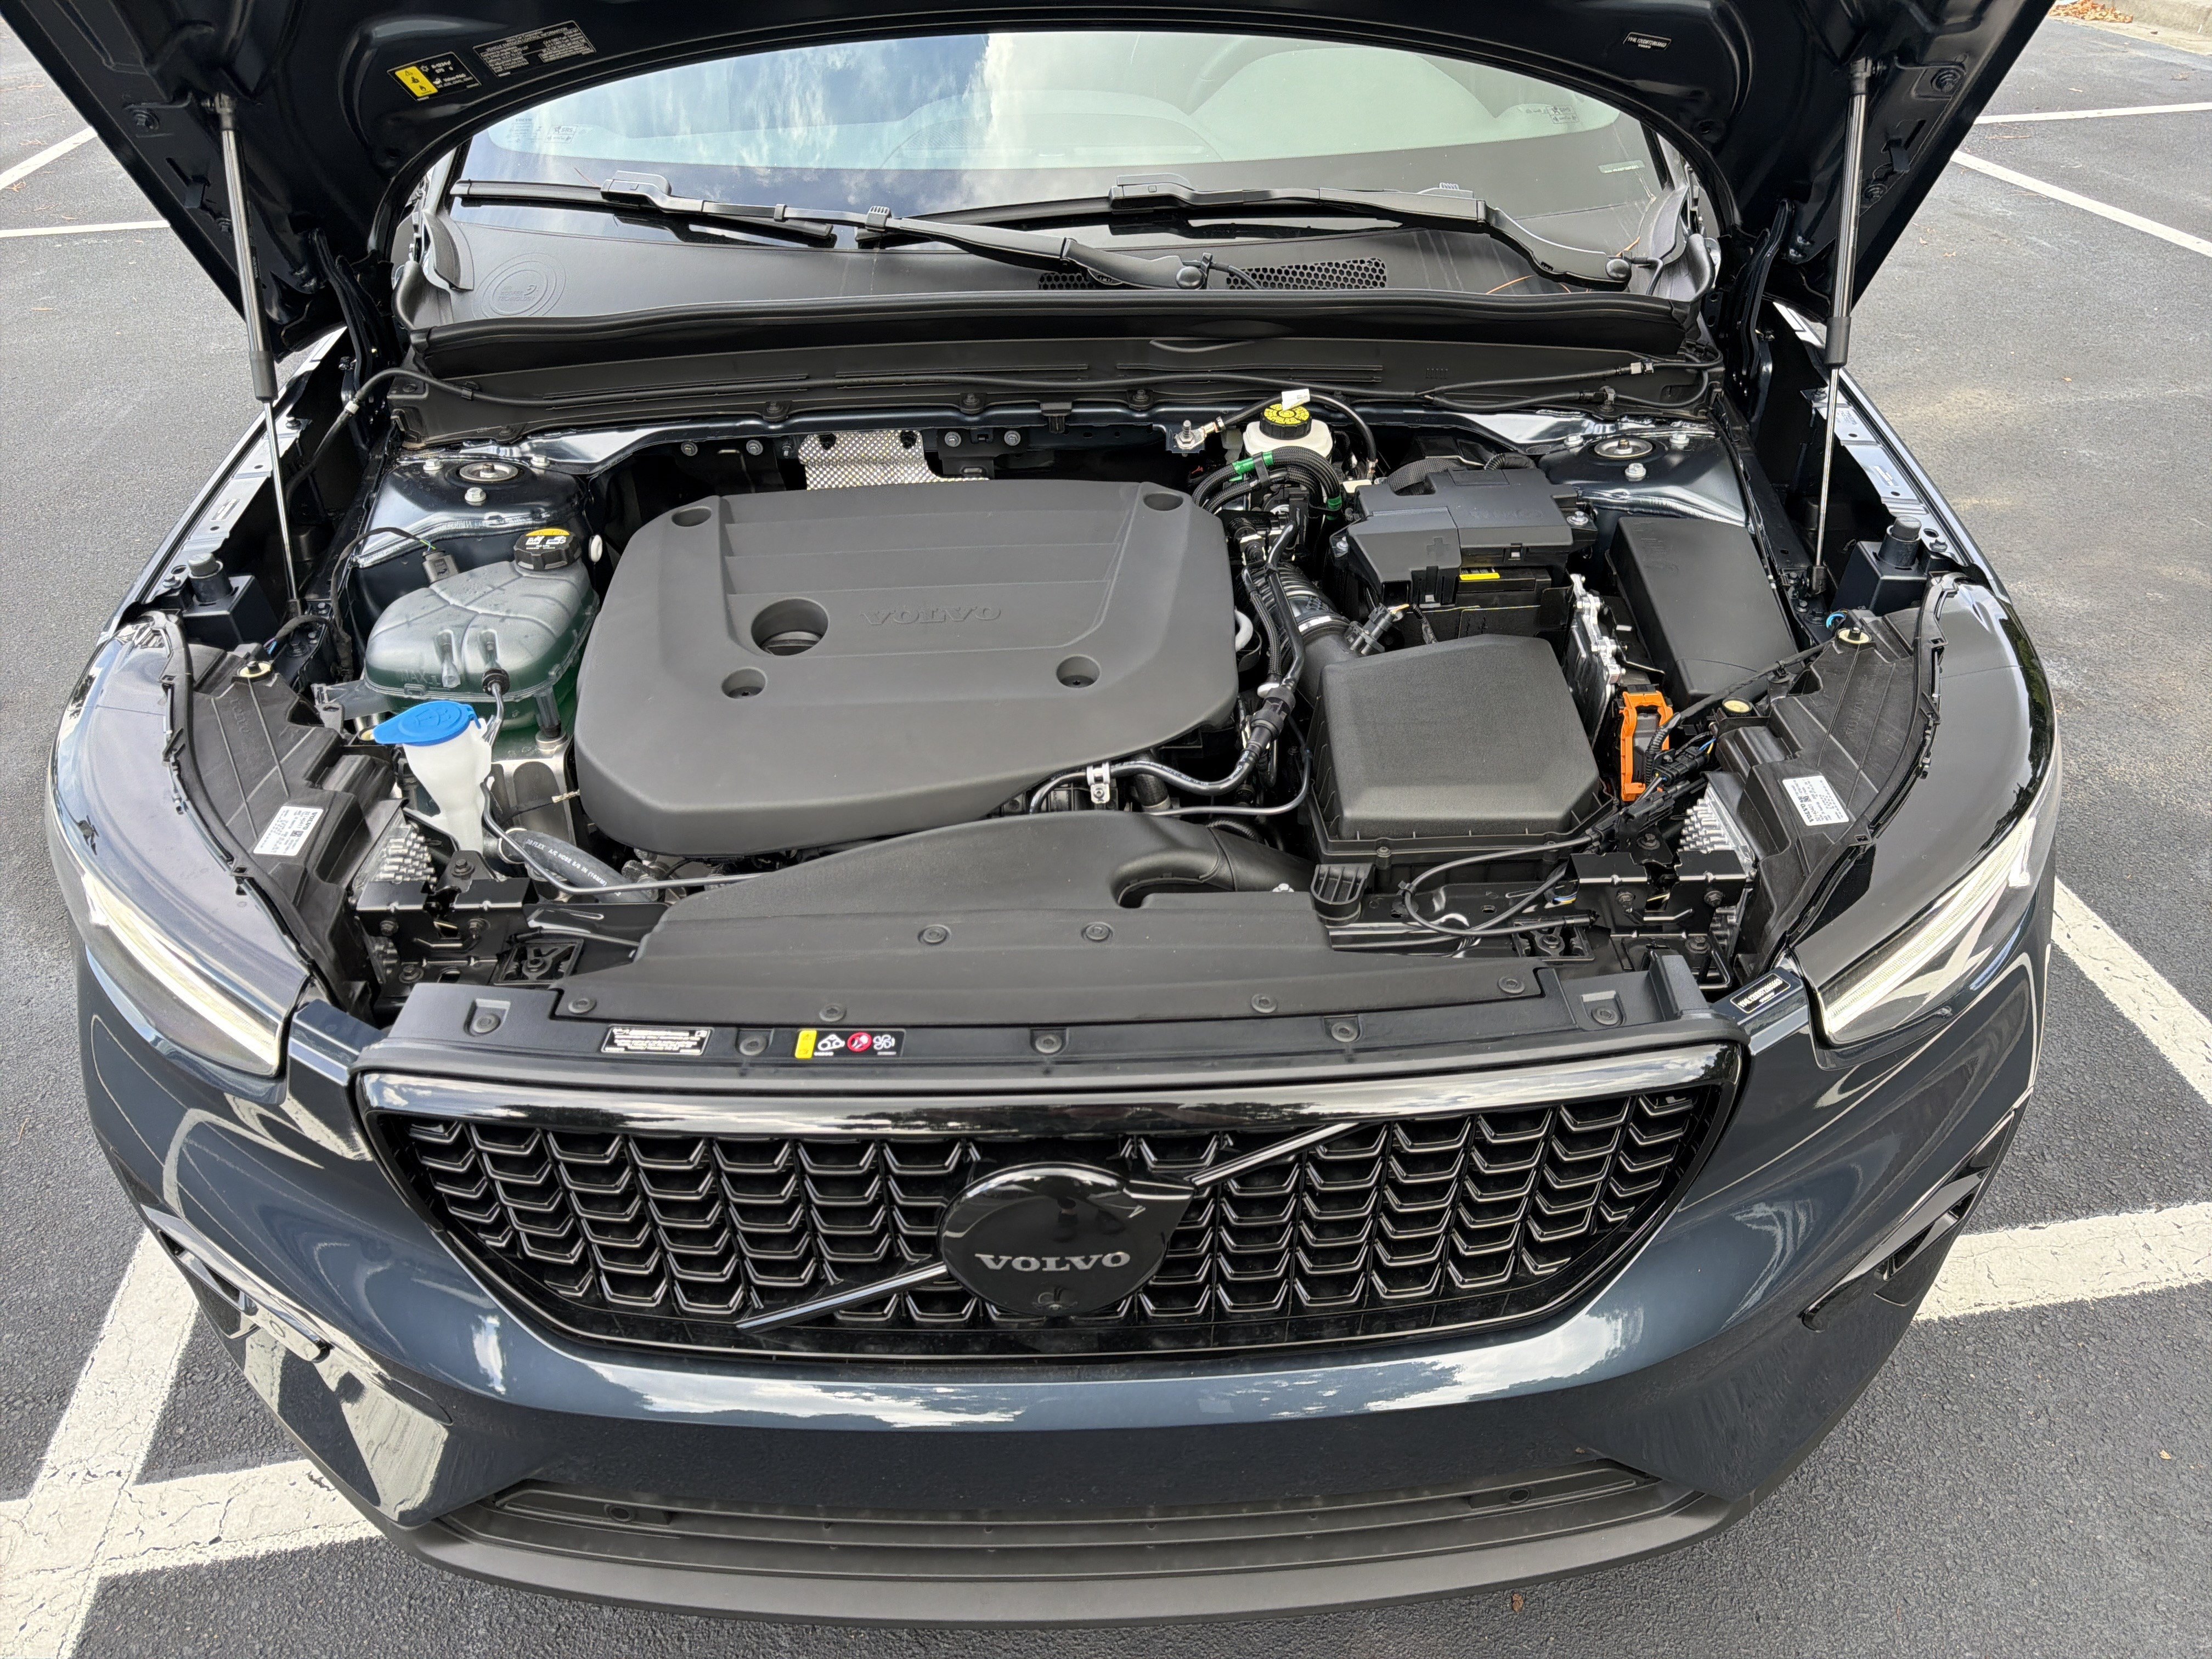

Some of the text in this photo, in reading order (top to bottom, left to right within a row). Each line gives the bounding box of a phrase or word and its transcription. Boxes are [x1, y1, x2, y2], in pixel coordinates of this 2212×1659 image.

[860, 606, 1002, 626] VOLVO
[302, 812, 318, 830] VOLVO
[1800, 804, 1814, 822] VOLVO
[558, 853, 572, 864] HOSE
[975, 1251, 1130, 1272] VOLVO
